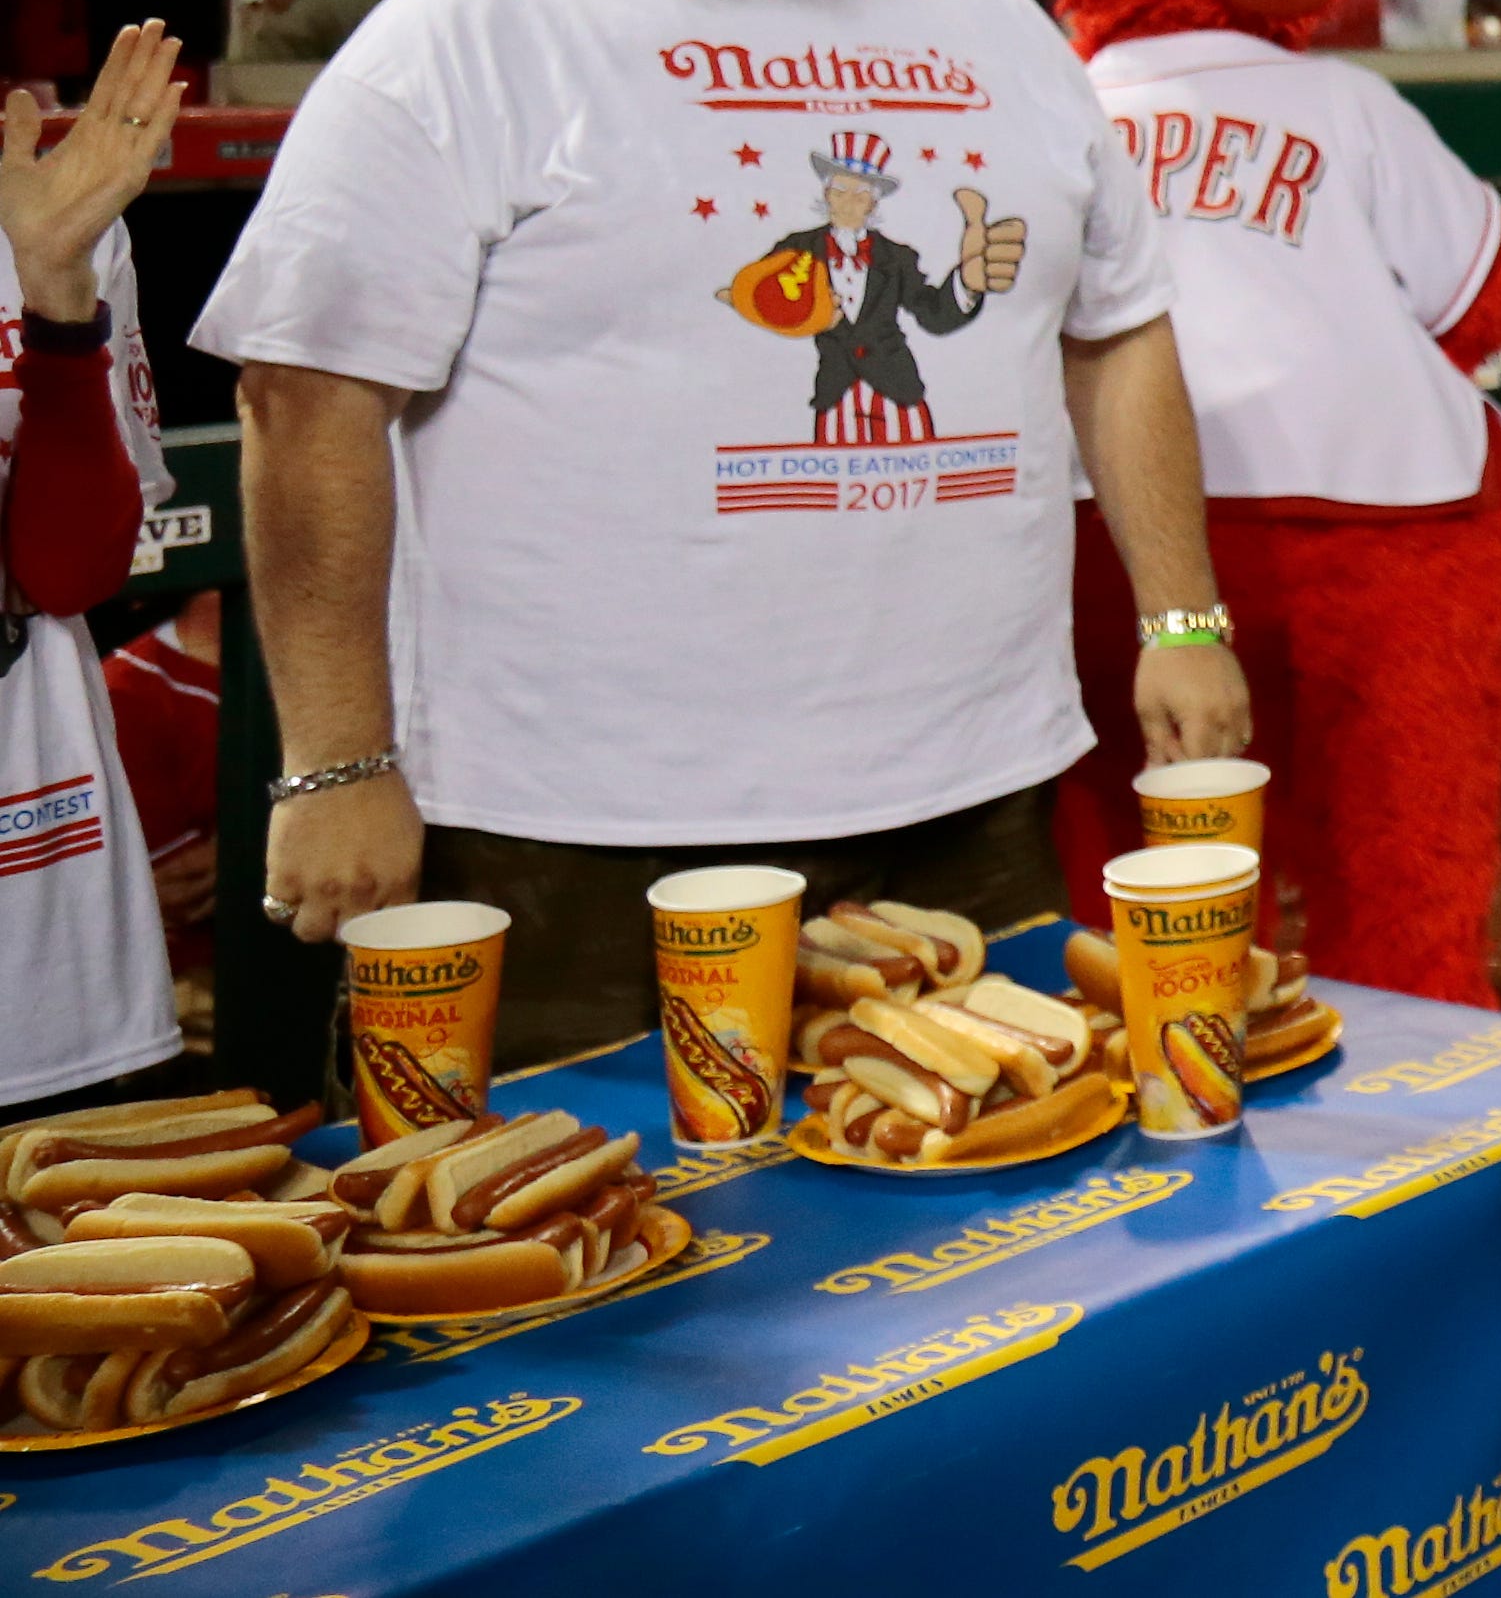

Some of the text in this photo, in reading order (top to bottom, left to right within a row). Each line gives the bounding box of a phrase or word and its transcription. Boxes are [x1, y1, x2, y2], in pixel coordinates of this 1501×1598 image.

[660, 40, 980, 94] Nathan's
[717, 445, 1018, 478] HOT DOG EATING CONTEST
[846, 477, 930, 511] 2017
[641, 1303, 1058, 1456] Nathan's
[31, 1396, 560, 1582] Nathan's
[1052, 1350, 1364, 1542] Nathan's
